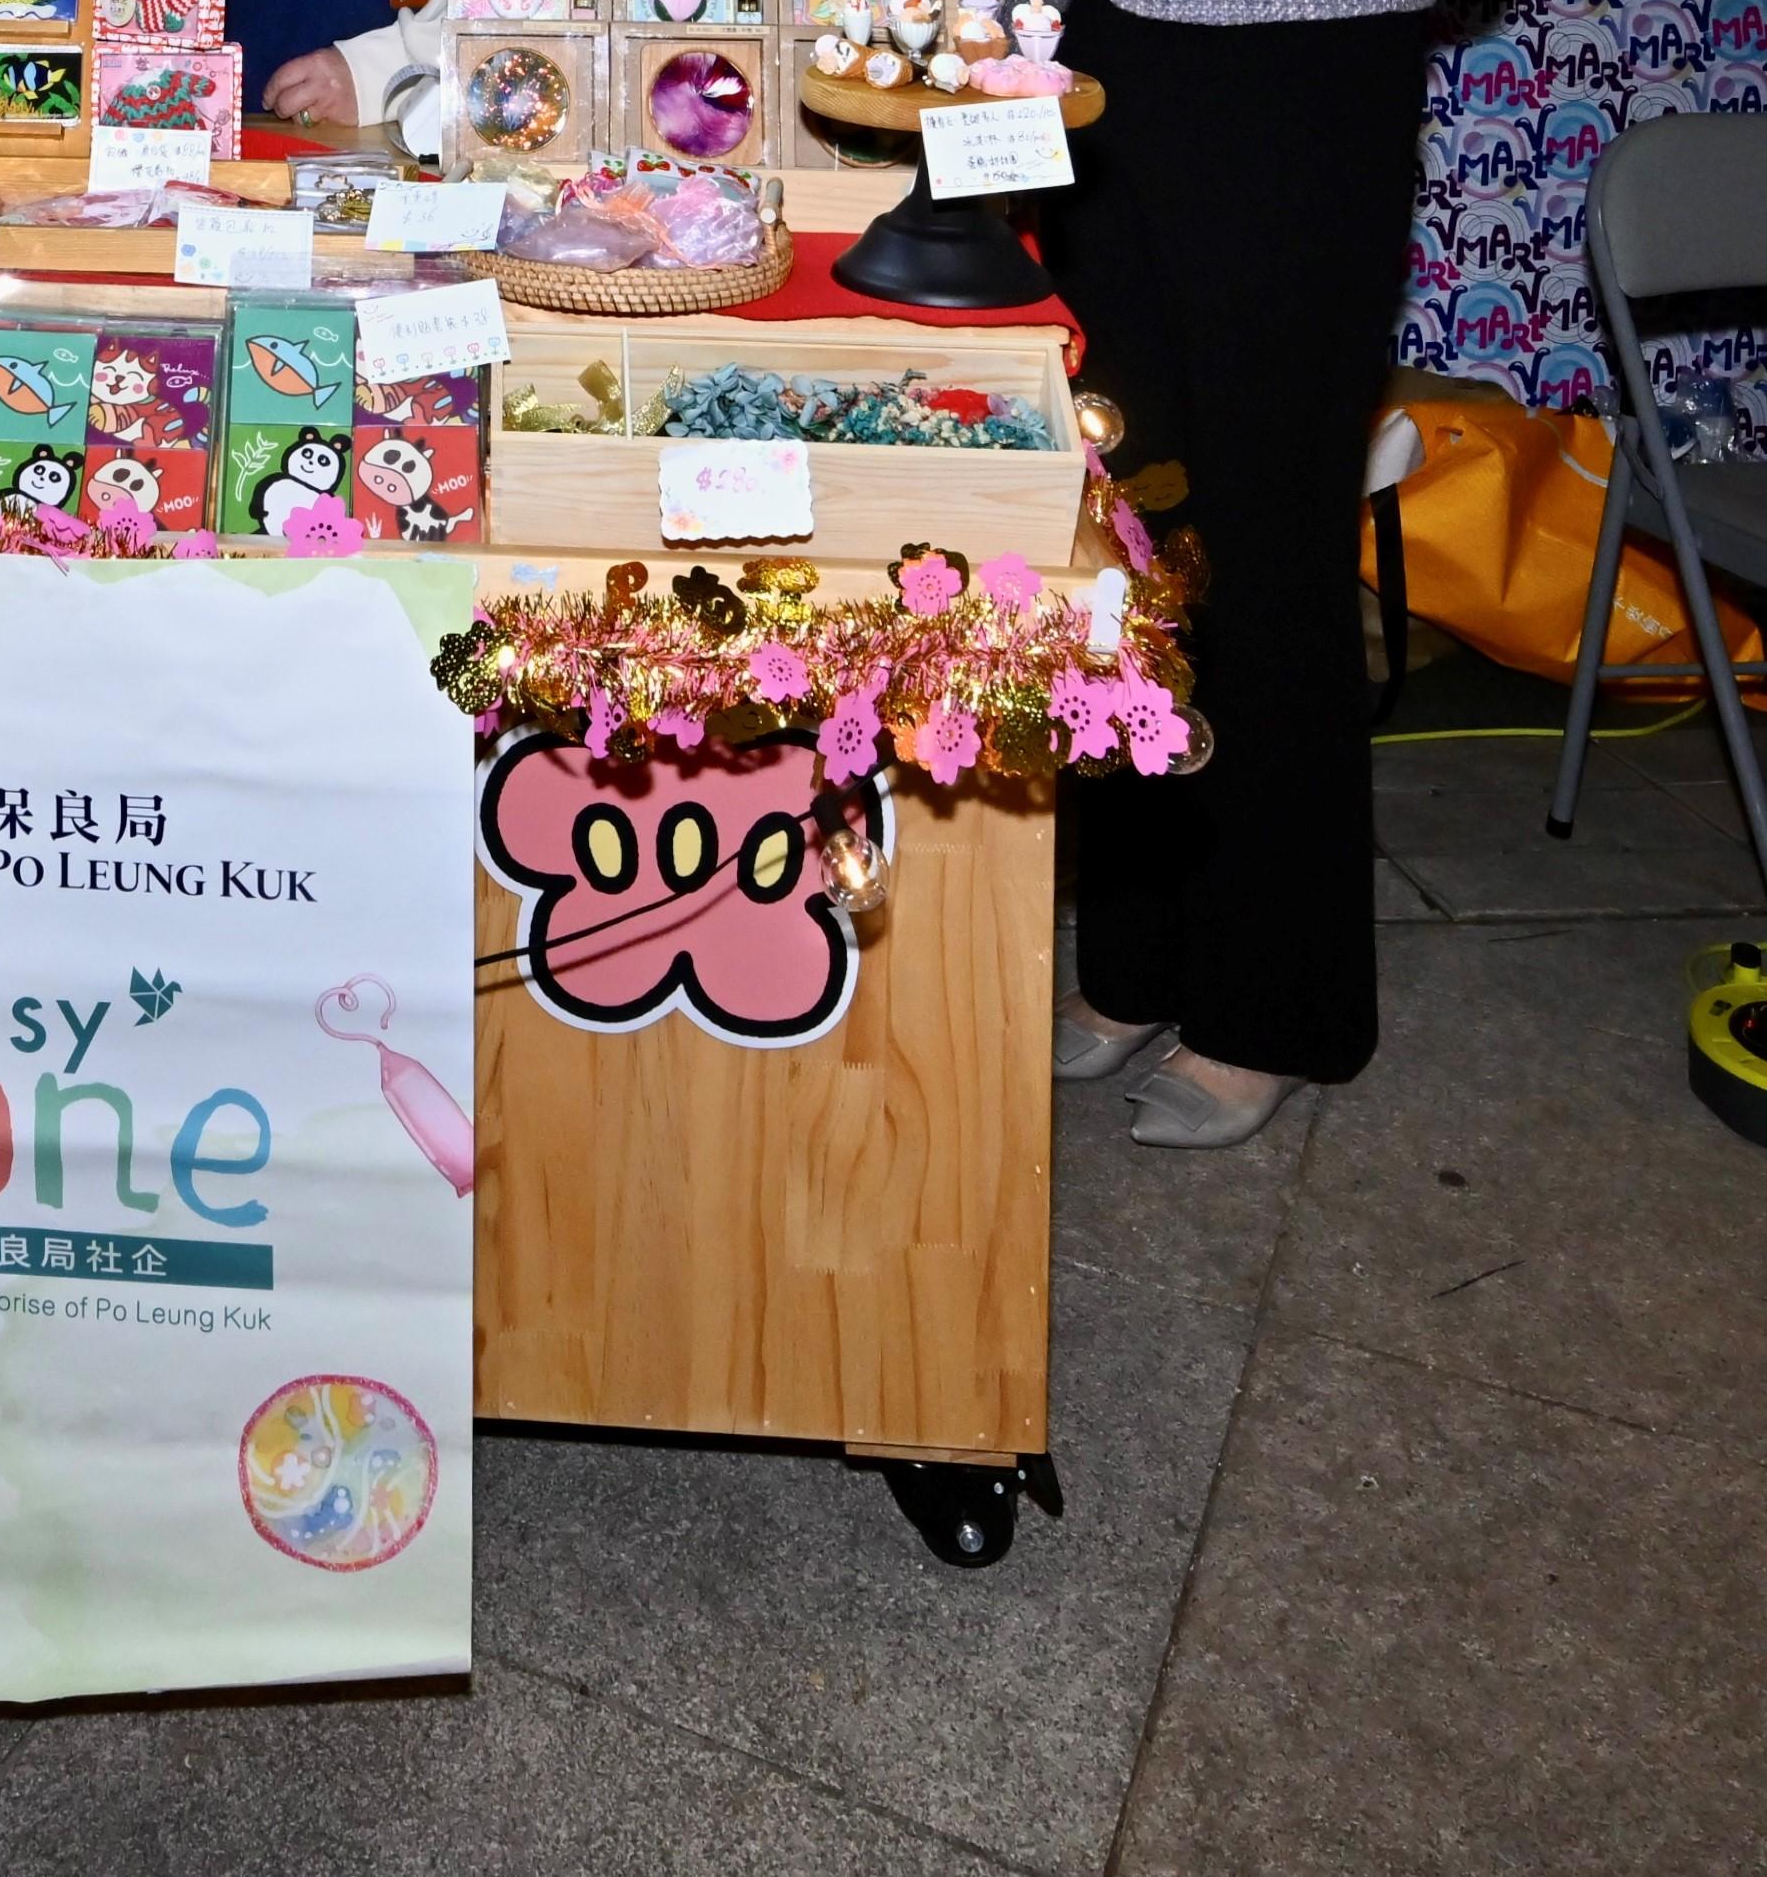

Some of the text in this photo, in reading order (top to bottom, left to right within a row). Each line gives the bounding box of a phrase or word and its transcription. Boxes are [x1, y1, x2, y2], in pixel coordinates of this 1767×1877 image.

[438, 475, 470, 495] MOO
[163, 495, 193, 512] MOO
[64, 1297, 88, 1318] of
[96, 1298, 128, 1322] Po
[136, 1301, 215, 1334] Leung
[223, 1306, 272, 1332] Kuk
